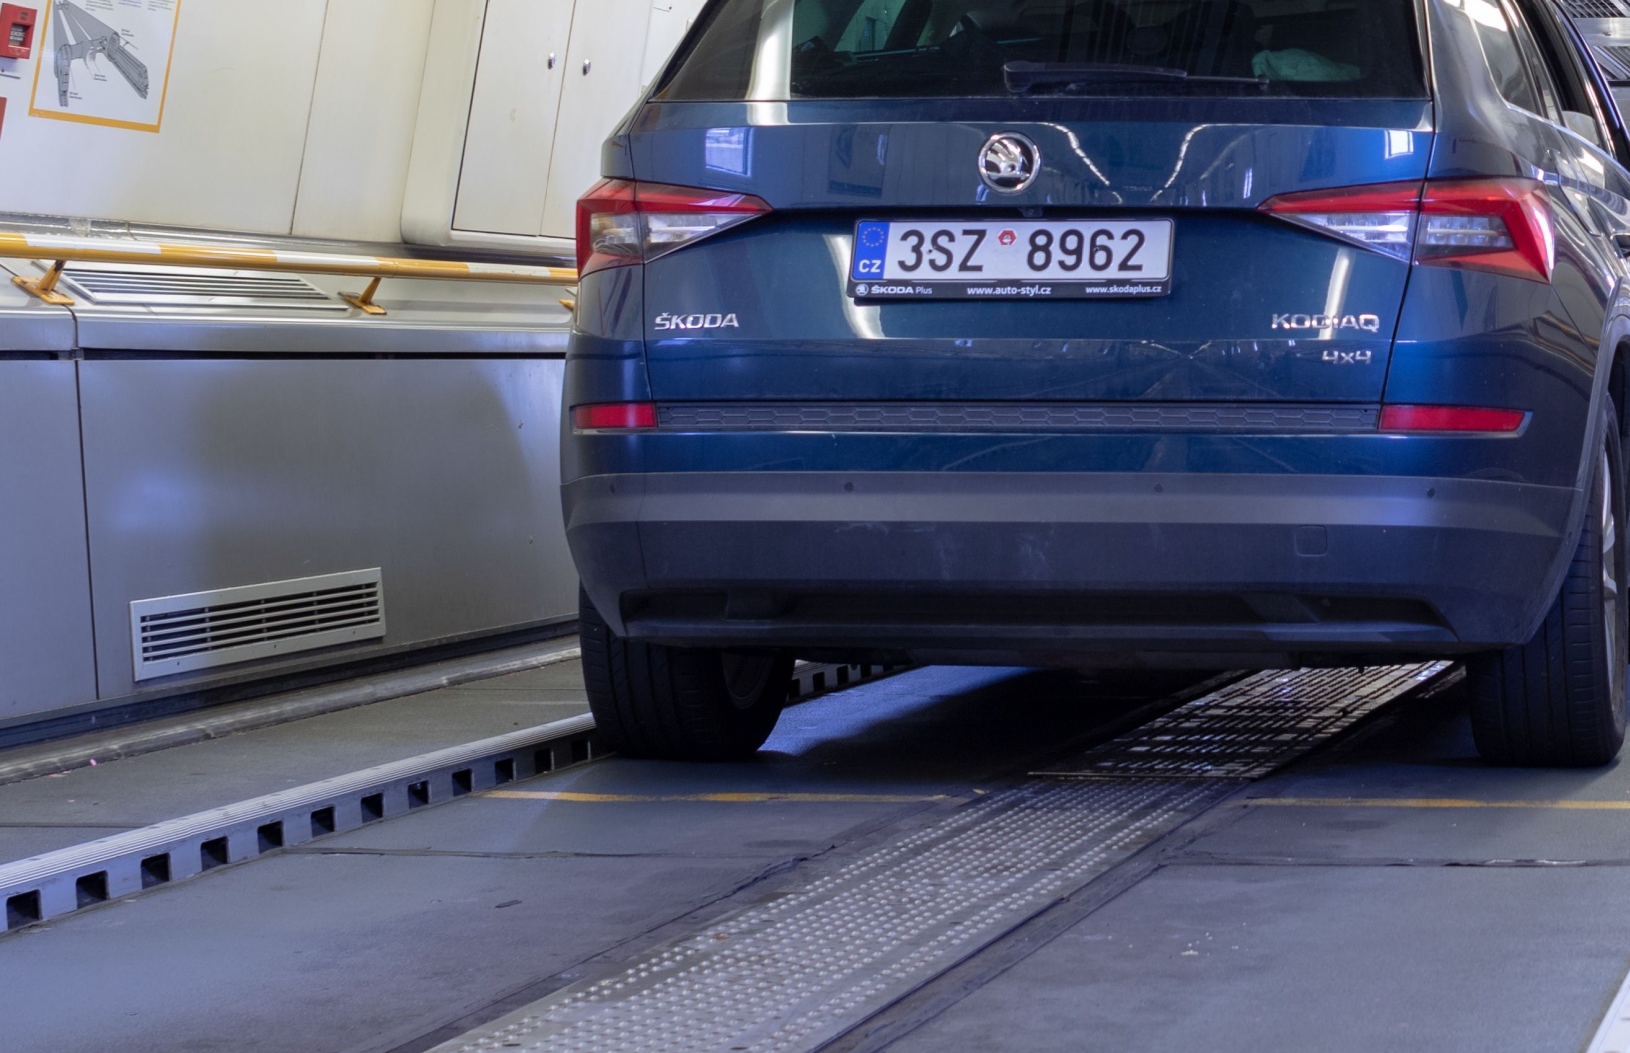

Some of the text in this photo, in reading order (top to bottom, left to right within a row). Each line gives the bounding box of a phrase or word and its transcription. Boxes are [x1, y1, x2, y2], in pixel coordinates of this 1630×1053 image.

[897, 228, 1146, 273] 3SZ 8962
[858, 259, 882, 273] CZ
[871, 284, 933, 294] ŠKODA Plus
[967, 285, 1052, 296] www.auto-styl.cz
[1085, 284, 1162, 295] www.skodaplus.cz
[654, 312, 739, 330] ŠKODA
[1271, 313, 1380, 332] KODIAQ
[1322, 350, 1371, 364] 4x4
